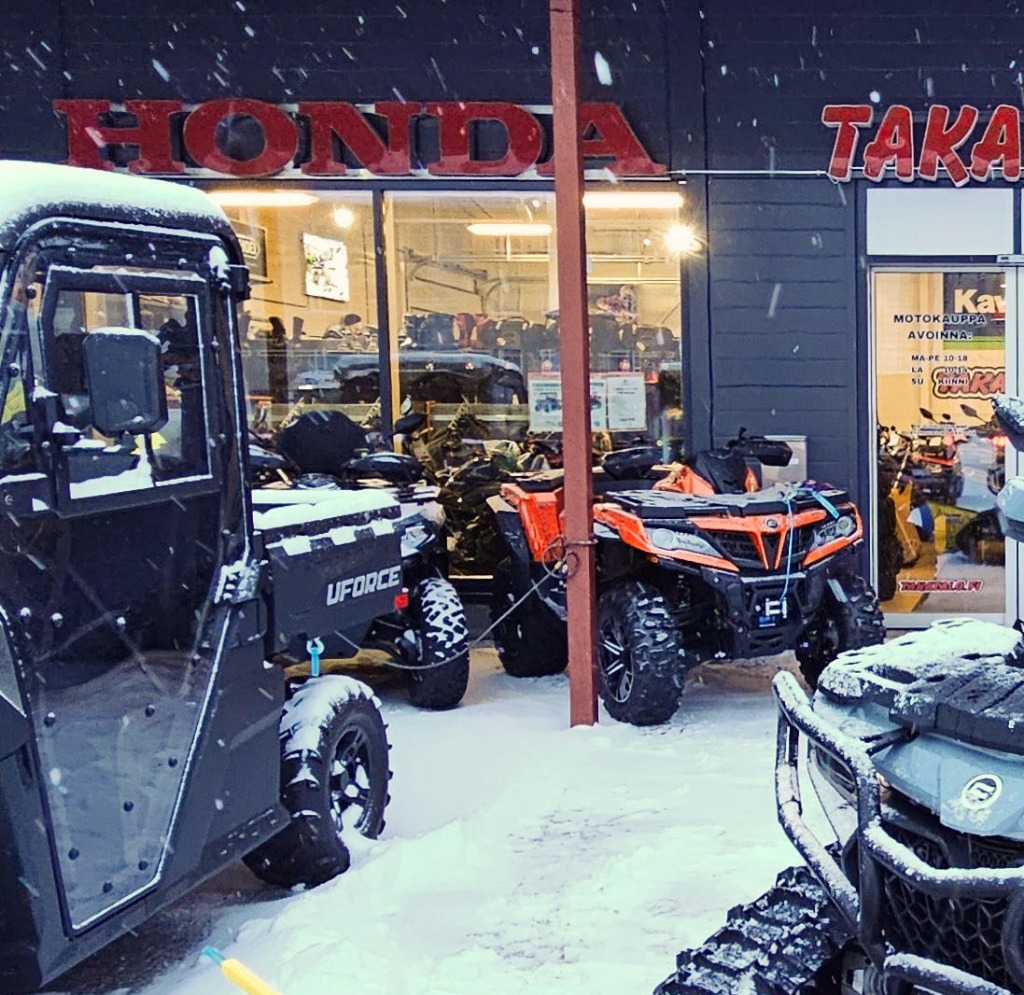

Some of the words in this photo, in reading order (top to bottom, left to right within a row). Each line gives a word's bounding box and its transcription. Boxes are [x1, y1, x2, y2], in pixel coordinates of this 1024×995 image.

[52, 98, 667, 177] HONDA
[893, 314, 987, 325] MOTOKAUPPA
[907, 331, 973, 340] AVOINNA:
[911, 378, 924, 386] SU
[326, 565, 402, 606] UFORCE
